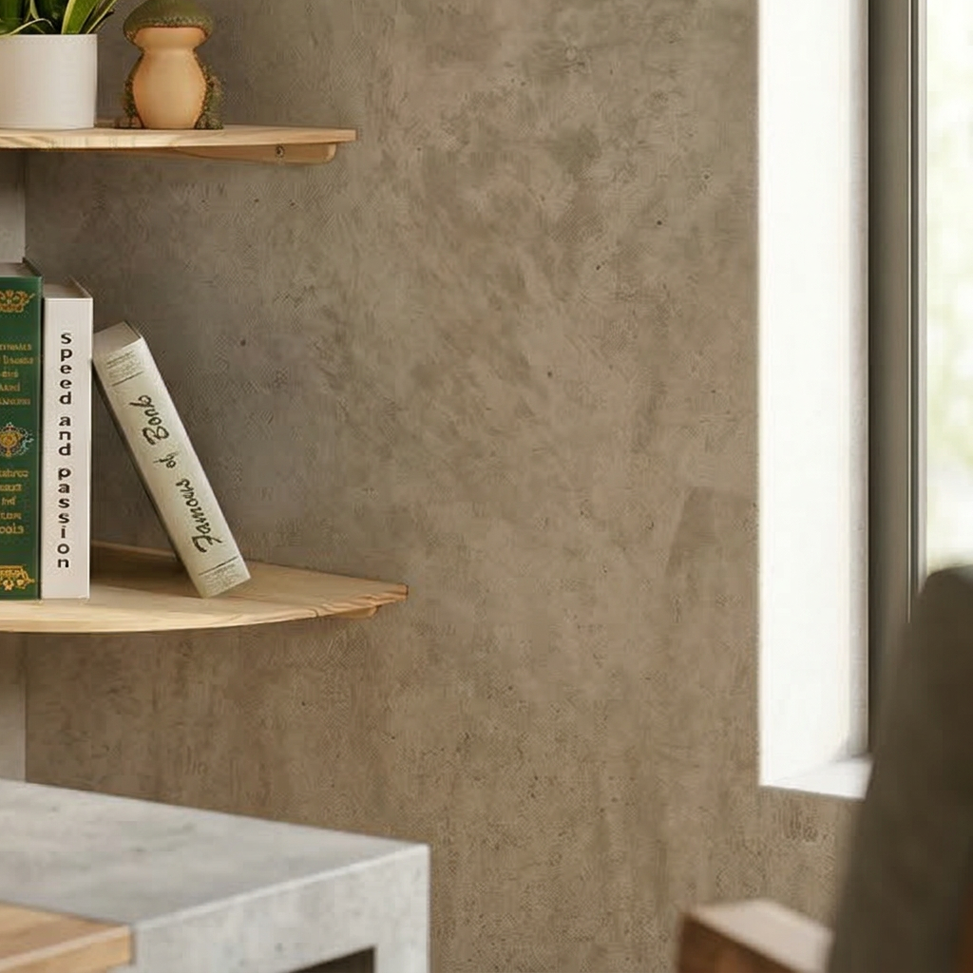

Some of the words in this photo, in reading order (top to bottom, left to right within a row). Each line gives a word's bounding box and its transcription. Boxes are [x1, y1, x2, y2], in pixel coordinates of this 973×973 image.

[59, 332, 73, 405] speed
[58, 415, 72, 456] and
[57, 467, 72, 568] passion
[175, 478, 223, 553] Famous
